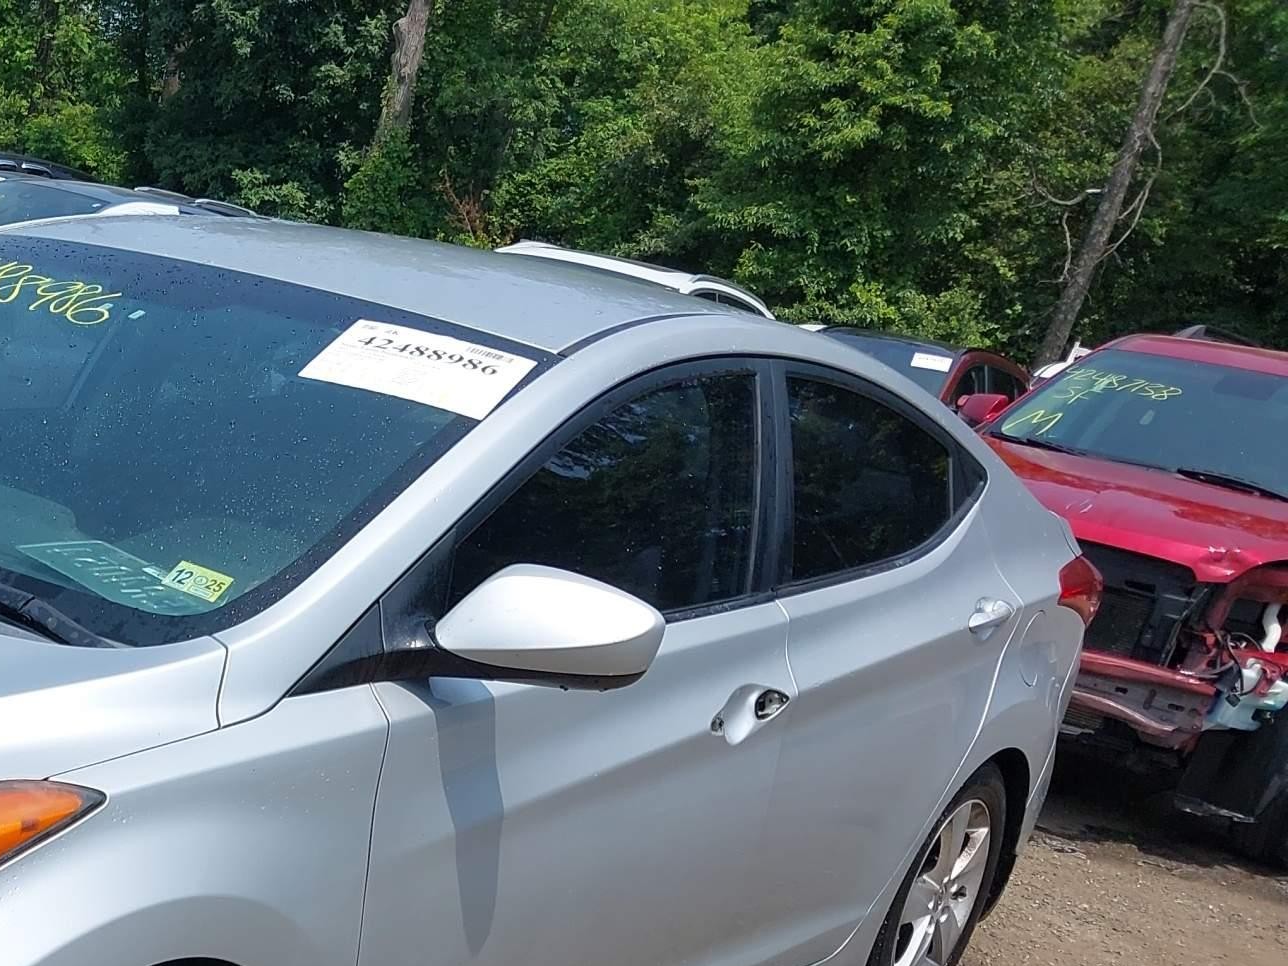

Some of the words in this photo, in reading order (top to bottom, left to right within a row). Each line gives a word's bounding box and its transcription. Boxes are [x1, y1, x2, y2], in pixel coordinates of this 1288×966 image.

[357, 336, 501, 376] 42488986
[172, 568, 194, 585] 12
[205, 579, 226, 593] 25
